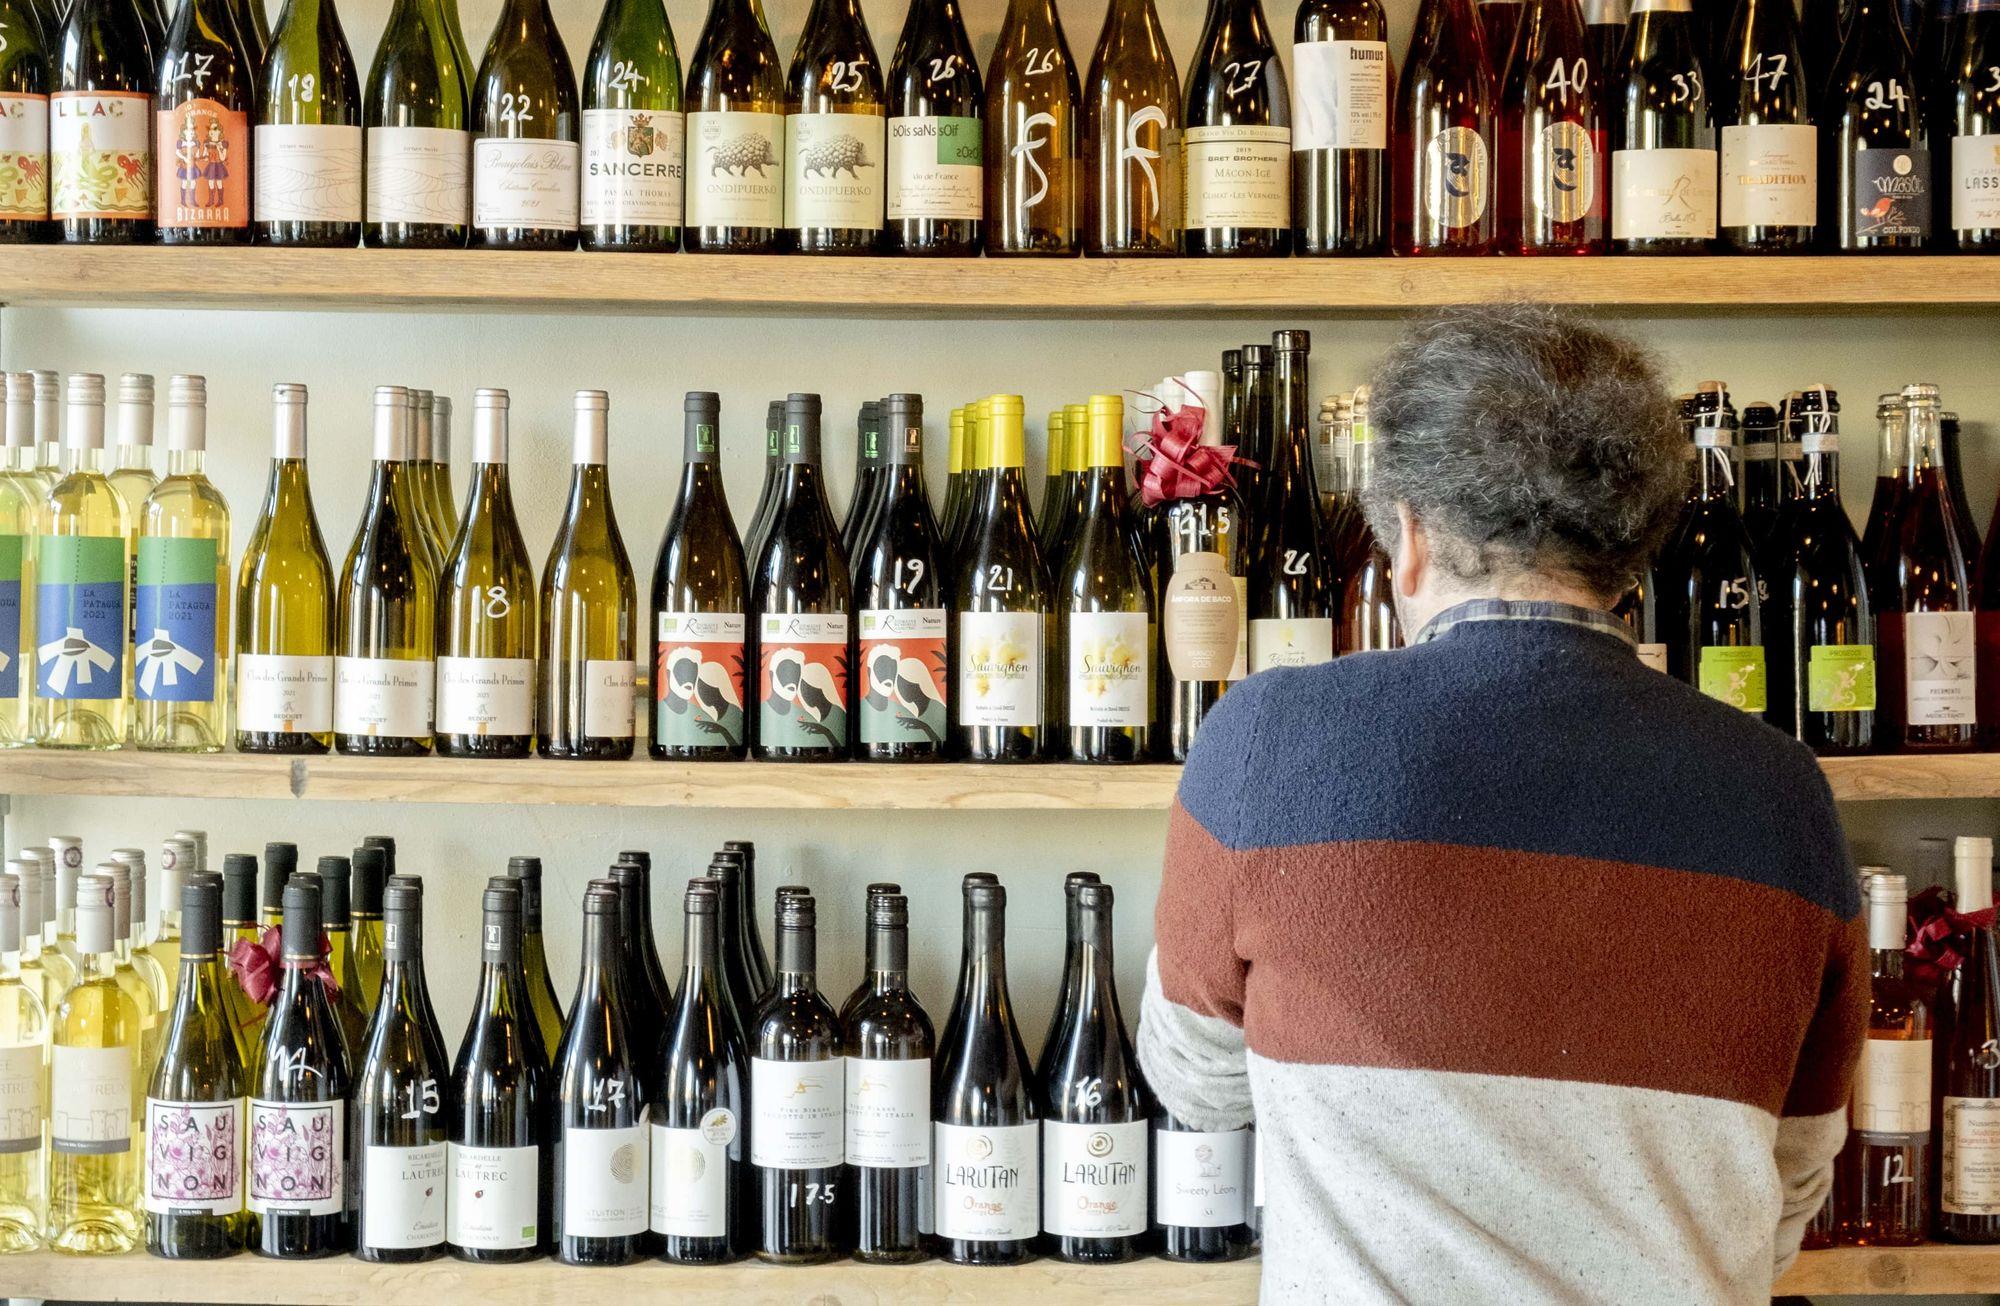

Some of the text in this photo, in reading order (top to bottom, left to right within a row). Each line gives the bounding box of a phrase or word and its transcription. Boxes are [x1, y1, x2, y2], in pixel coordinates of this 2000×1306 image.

[1025, 48, 1055, 75] 26
[1350, 47, 1384, 61] humus
[173, 51, 214, 88] 17
[608, 61, 645, 92] 24
[832, 61, 869, 92] 25
[930, 55, 956, 82] 26
[1224, 61, 1262, 98] 27
[1546, 57, 1588, 102] 40
[1744, 53, 1789, 93] 47
[1672, 71, 1702, 102] 33
[1865, 78, 1910, 112] 24
[500, 93, 534, 122] 22
[913, 124, 937, 137] saNs
[590, 162, 682, 178] SANCERRE
[935, 171, 960, 180] France
[1737, 174, 1808, 186] TRADITION
[1284, 549, 1311, 576] 26
[895, 557, 925, 595] 19
[986, 564, 1014, 592] 21
[82, 589, 95, 598] LA
[82, 600, 121, 609] PATAGUA
[168, 590, 181, 599] LA
[168, 601, 210, 610] PATAGUA
[486, 585, 511, 619] 8
[1213, 595, 1232, 604] BACO
[82, 610, 106, 619] 2021
[168, 611, 193, 620] 2021
[277, 669, 306, 683] Grands
[966, 654, 1030, 678] Sauvignon
[1080, 654, 1143, 677] Sauvignon
[603, 675, 619, 687] Clos
[401, 1078, 440, 1119] 15
[588, 1078, 626, 1113] 17
[1074, 1075, 1103, 1108] 16
[455, 1168, 509, 1182] LAUTREC
[945, 1162, 1020, 1189] LARUTAN
[1063, 1162, 1136, 1187] LARUTAN
[1882, 1154, 1915, 1187] 12
[963, 1195, 1005, 1216] Orange
[1076, 1196, 1119, 1215] Orange
